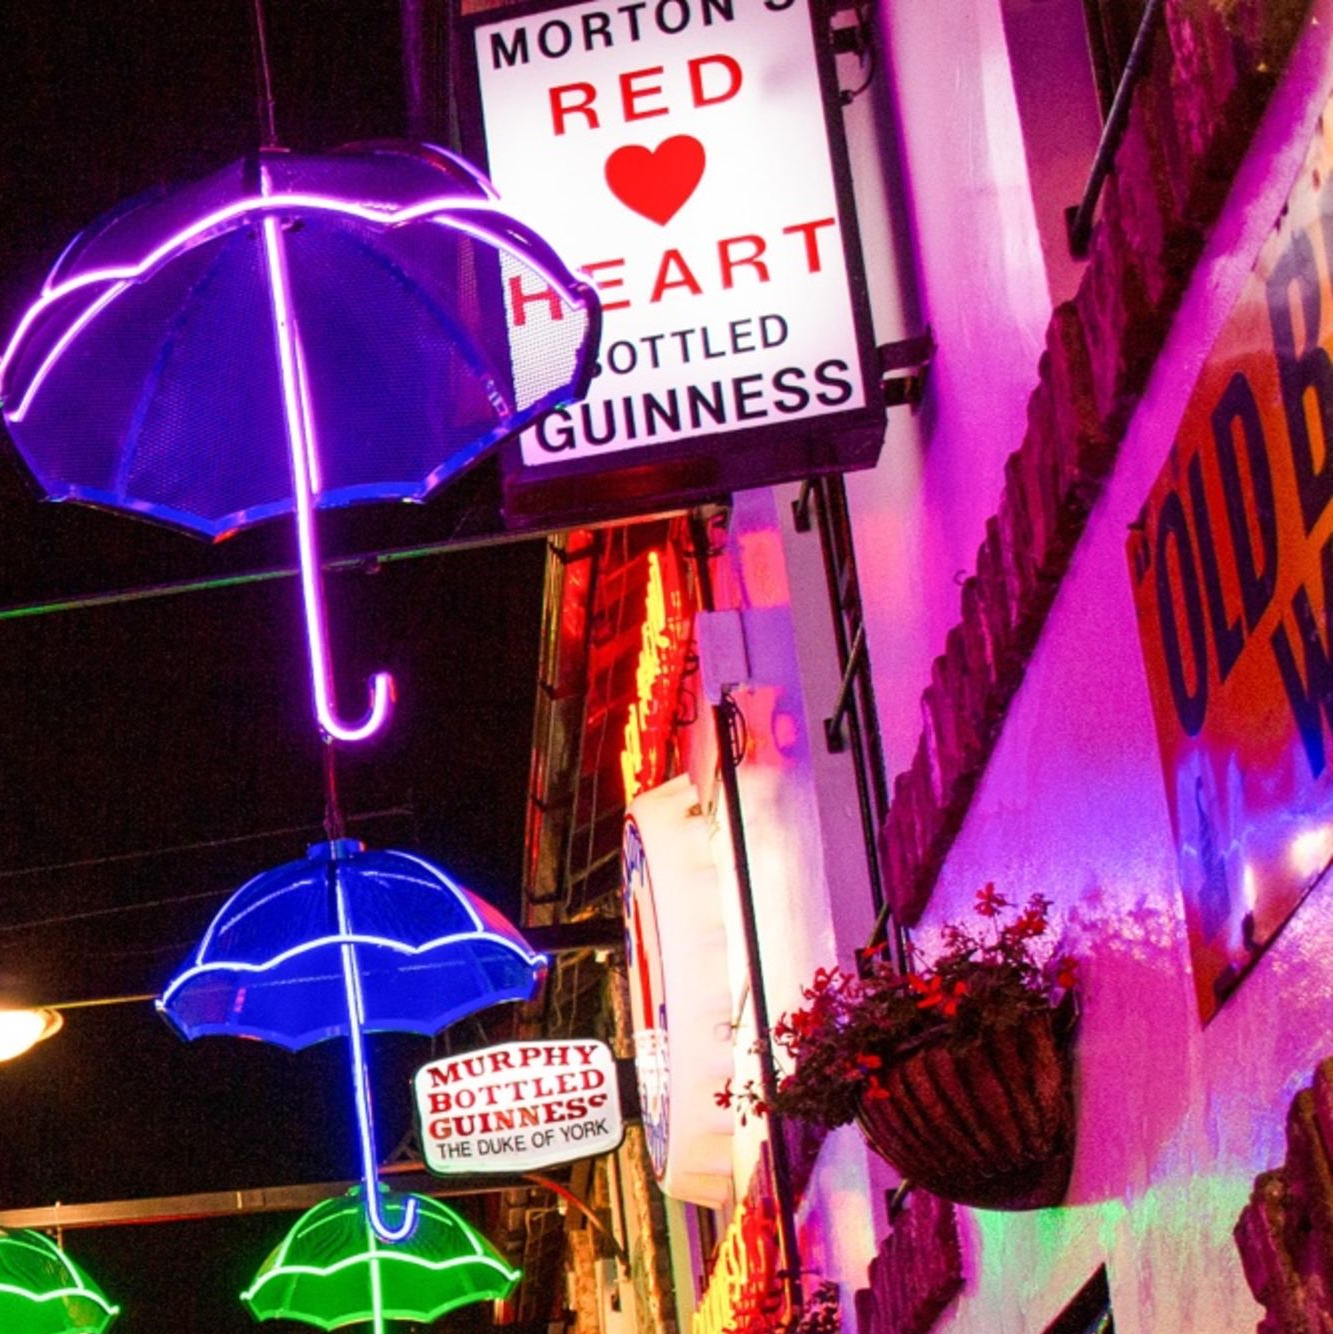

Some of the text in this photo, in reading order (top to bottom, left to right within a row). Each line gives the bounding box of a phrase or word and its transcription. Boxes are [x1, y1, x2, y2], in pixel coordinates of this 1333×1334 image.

[548, 53, 744, 136] RED
[508, 217, 837, 327] HEART
[590, 314, 789, 379] OTTLED
[535, 360, 853, 454] GUINNESS
[428, 1044, 599, 1089] MURPHY
[429, 1068, 606, 1115] BOTTLED
[436, 1118, 609, 1160] THE DUKE OF YORK
